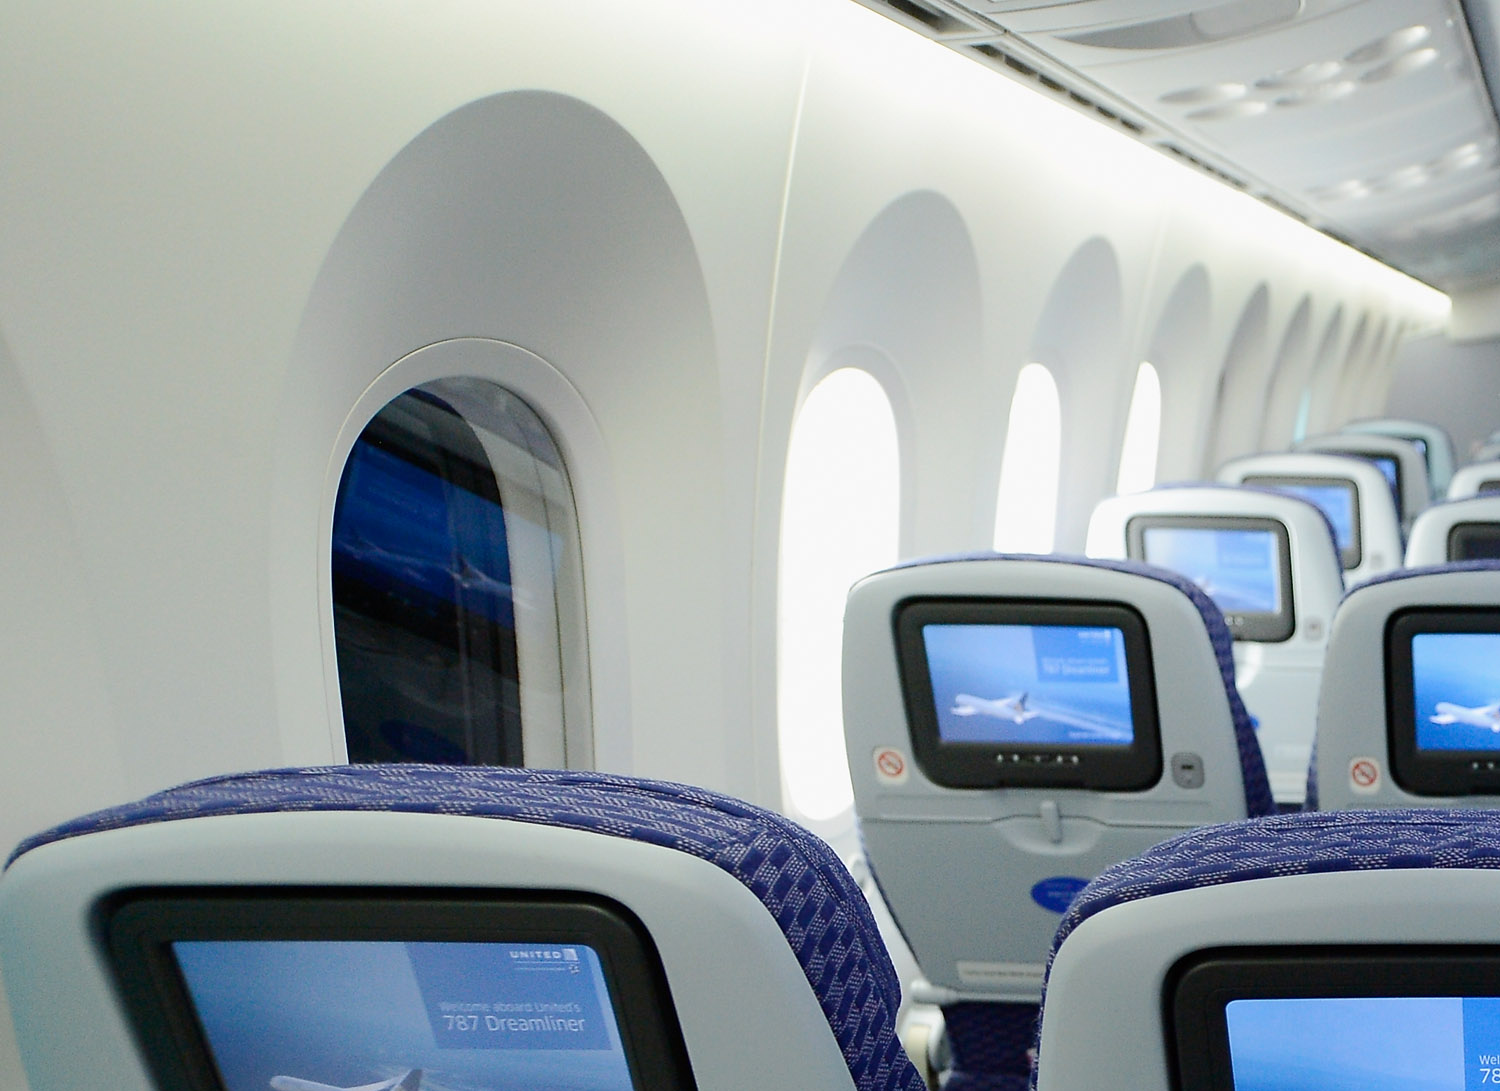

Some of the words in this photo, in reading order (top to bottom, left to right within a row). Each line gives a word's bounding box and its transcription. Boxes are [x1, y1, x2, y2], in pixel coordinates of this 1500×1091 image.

[509, 950, 562, 959] UNITED
[438, 1001, 490, 1012] Welcome
[493, 1002, 533, 1012] aboard
[442, 1015, 479, 1031] 787
[484, 1015, 586, 1032] Dreamliner
